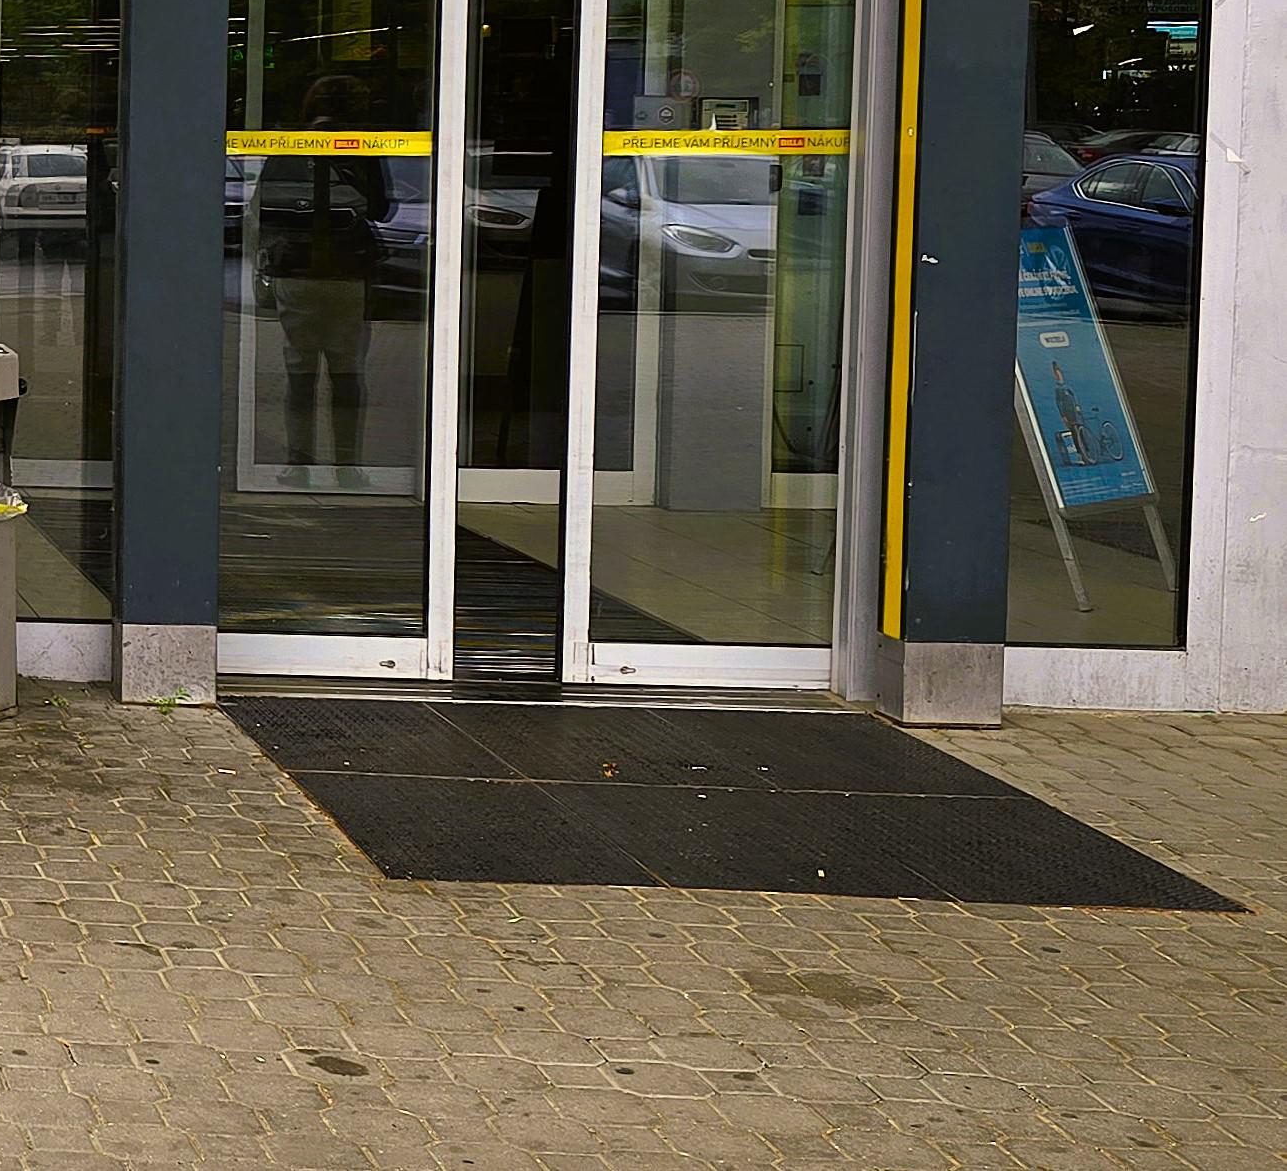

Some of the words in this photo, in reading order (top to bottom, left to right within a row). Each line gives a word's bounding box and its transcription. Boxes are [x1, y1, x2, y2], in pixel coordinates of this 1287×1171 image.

[242, 137, 267, 149] VÁM
[270, 136, 331, 150] PŘÍJEMNÝ
[623, 135, 680, 149] PŘEJEME
[682, 135, 710, 149] VÁM
[714, 134, 776, 149] PŘÍJEMNÝ
